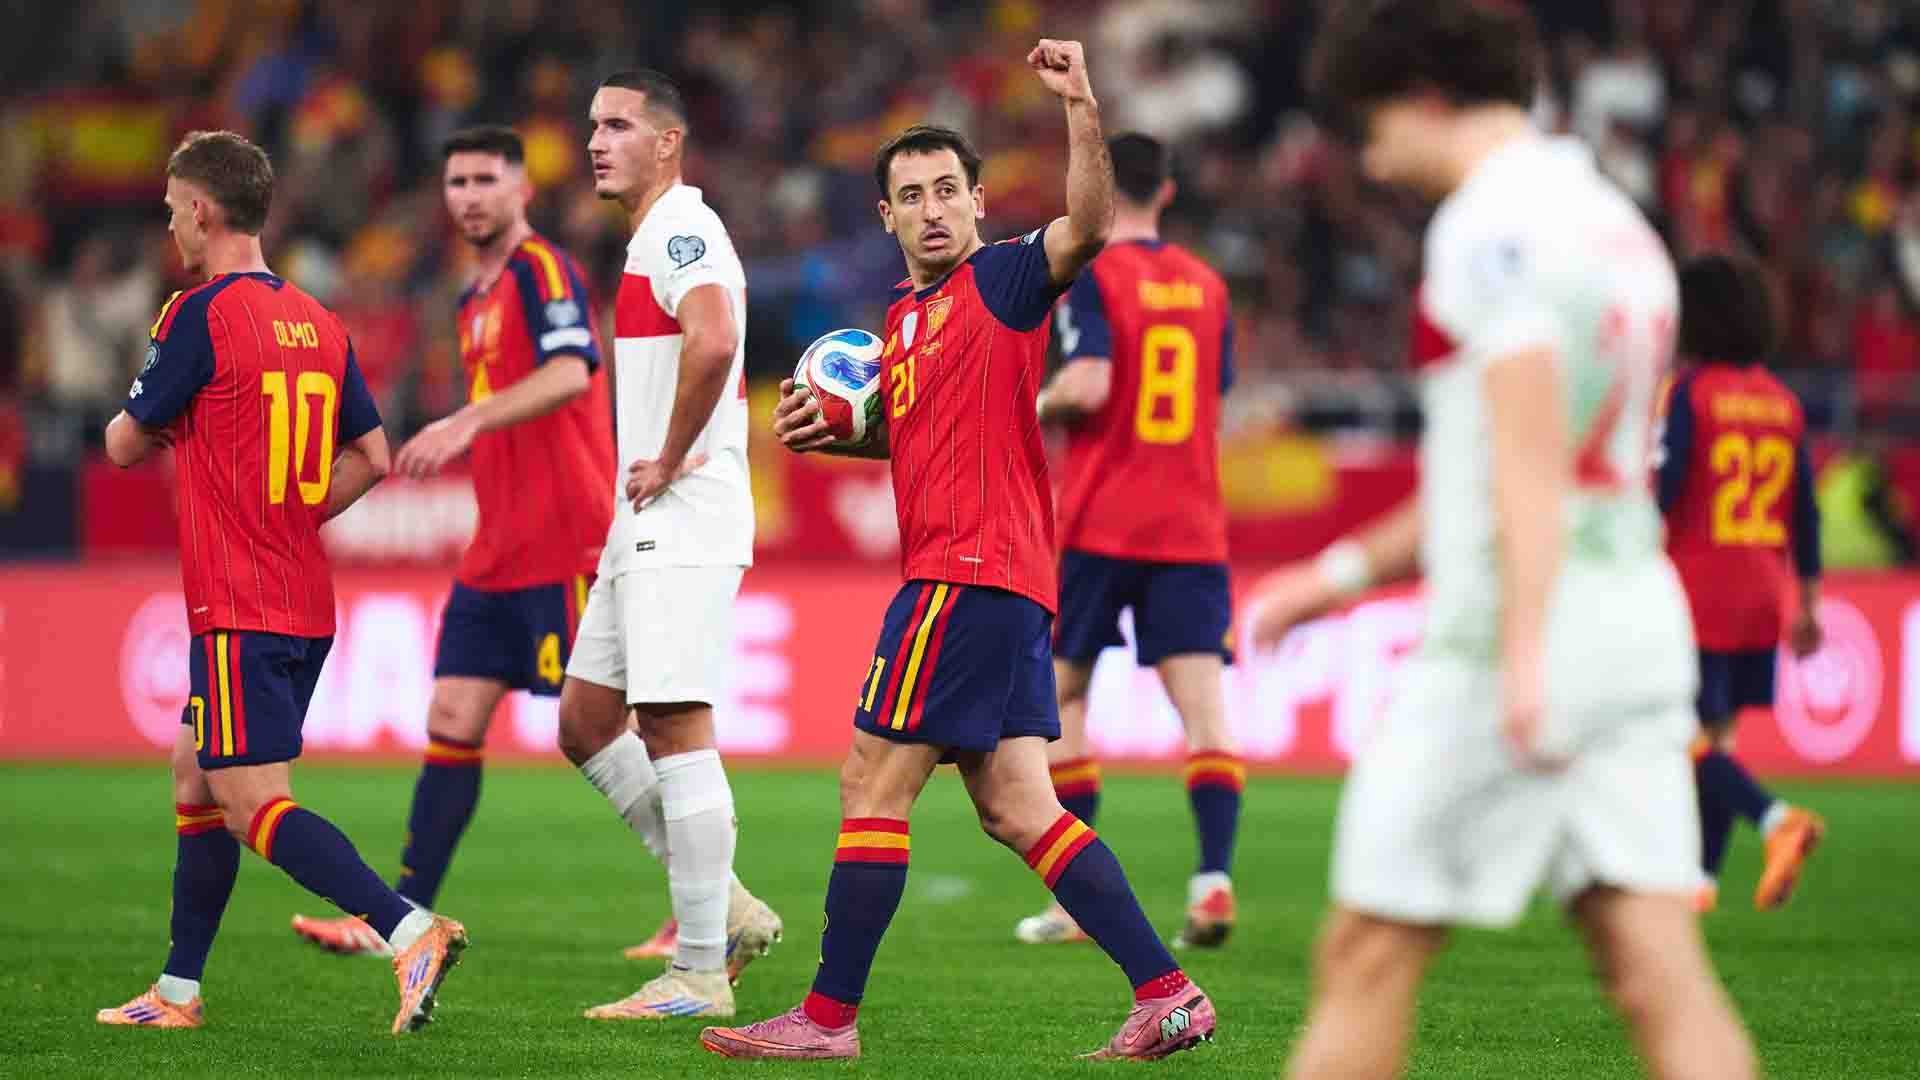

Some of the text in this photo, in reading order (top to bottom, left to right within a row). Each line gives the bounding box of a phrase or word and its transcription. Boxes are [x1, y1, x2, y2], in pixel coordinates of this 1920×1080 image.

[273, 320, 319, 348] OLMO
[891, 354, 915, 417] 21
[1136, 324, 1198, 444] 8
[261, 371, 337, 505] 10
[1711, 432, 1793, 545] 22
[537, 632, 562, 686] 4
[859, 656, 886, 712] 1
[191, 696, 205, 752] 0
